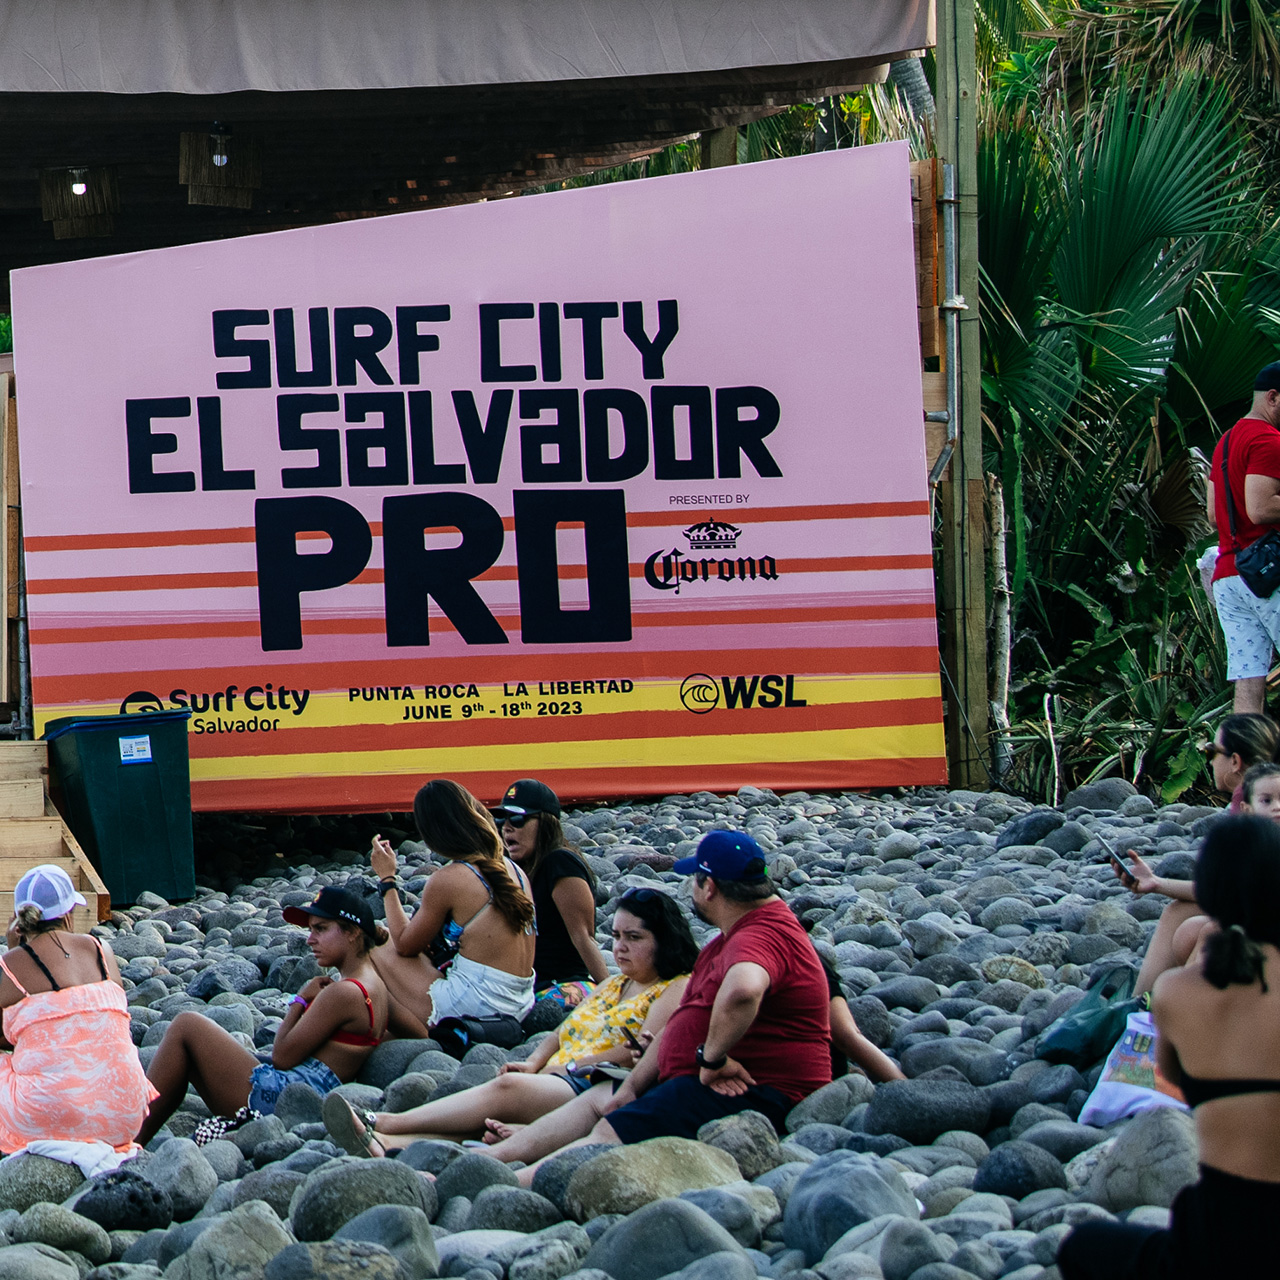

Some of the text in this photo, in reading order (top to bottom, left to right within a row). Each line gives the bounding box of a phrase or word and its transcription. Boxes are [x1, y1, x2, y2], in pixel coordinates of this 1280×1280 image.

[212, 299, 679, 390] SURF CITY
[125, 396, 256, 495] EL
[669, 494, 750, 505] PRESENTED BY
[254, 488, 633, 652] PRO
[644, 547, 780, 595] Corona
[169, 683, 310, 716] Surf City
[348, 679, 634, 702] PUNTA ROCA LA LIBERTAD
[720, 674, 807, 710] WSL
[193, 716, 280, 735] Salvador
[402, 704, 452, 720] JUNE
[461, 702, 484, 718] 9th
[501, 700, 532, 717] 18th
[537, 700, 583, 716] 2023
